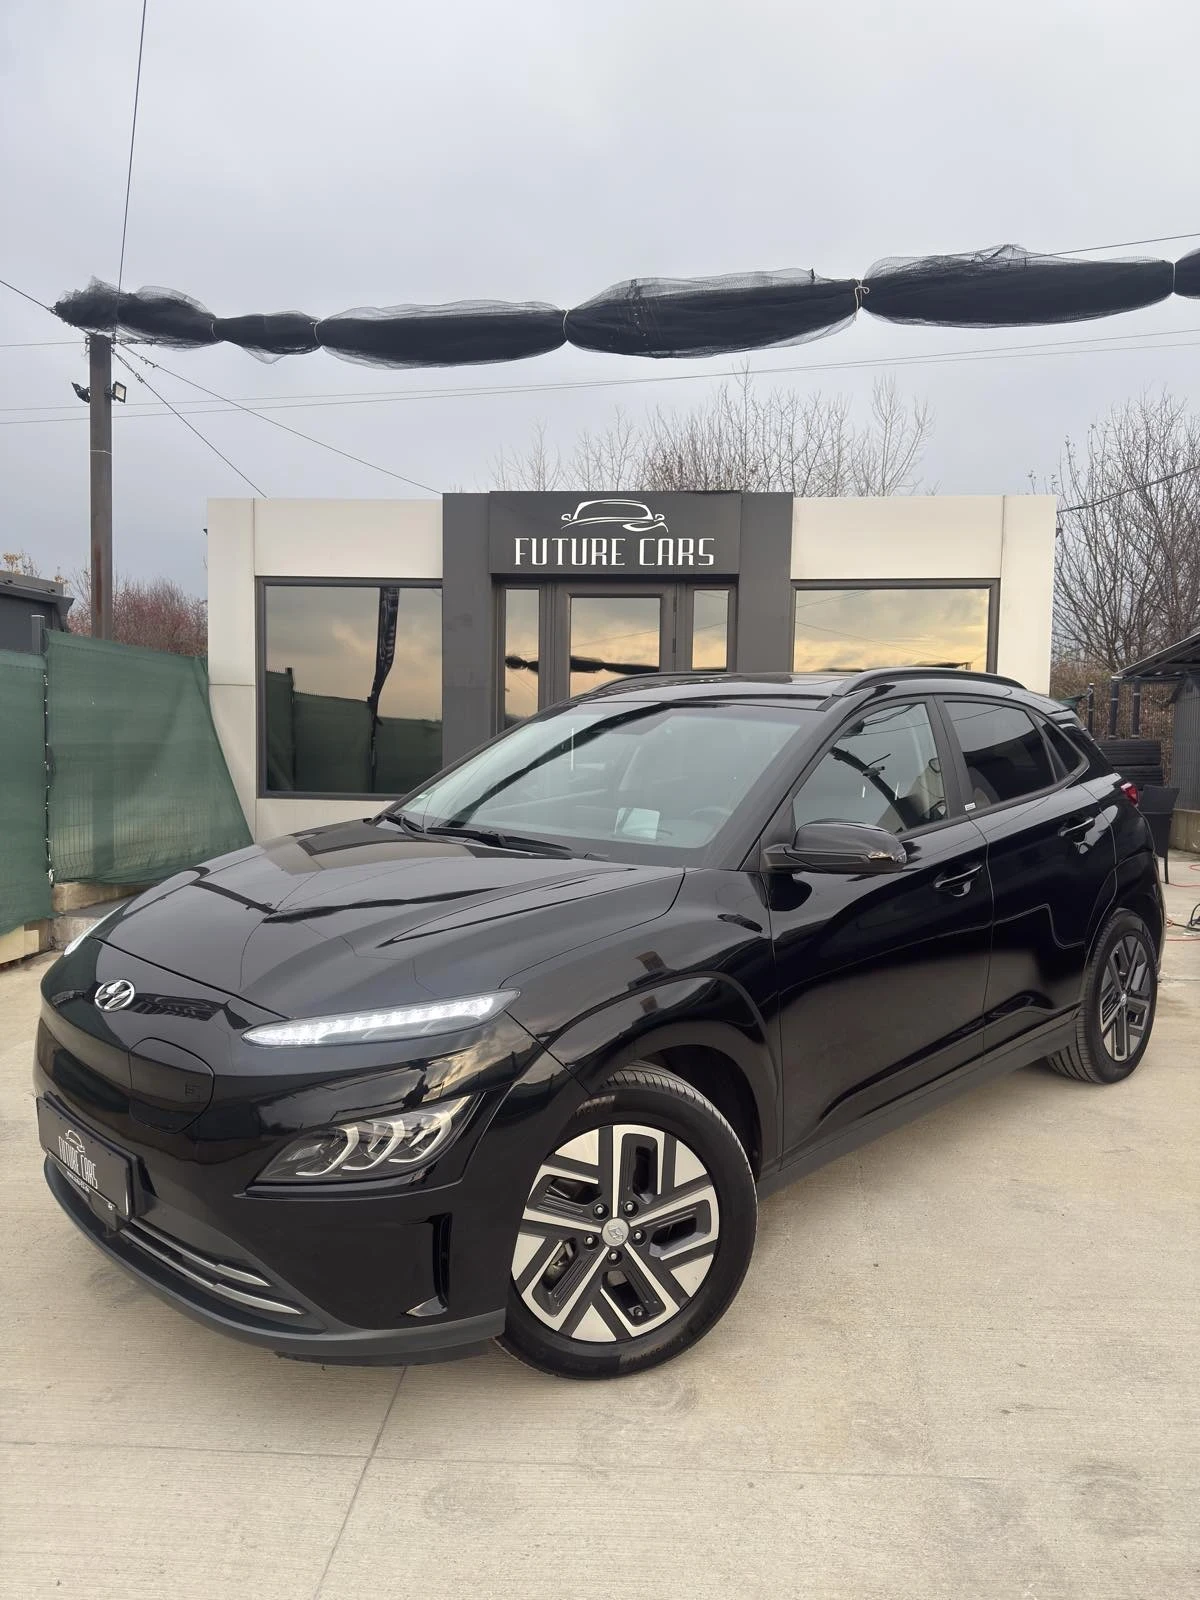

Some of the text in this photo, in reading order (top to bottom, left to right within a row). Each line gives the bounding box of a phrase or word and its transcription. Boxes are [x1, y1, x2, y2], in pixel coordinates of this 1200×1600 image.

[513, 538, 715, 566] FUTURE CARS
[58, 1135, 81, 1176] FUTURE
[80, 1154, 99, 1190] CARS
